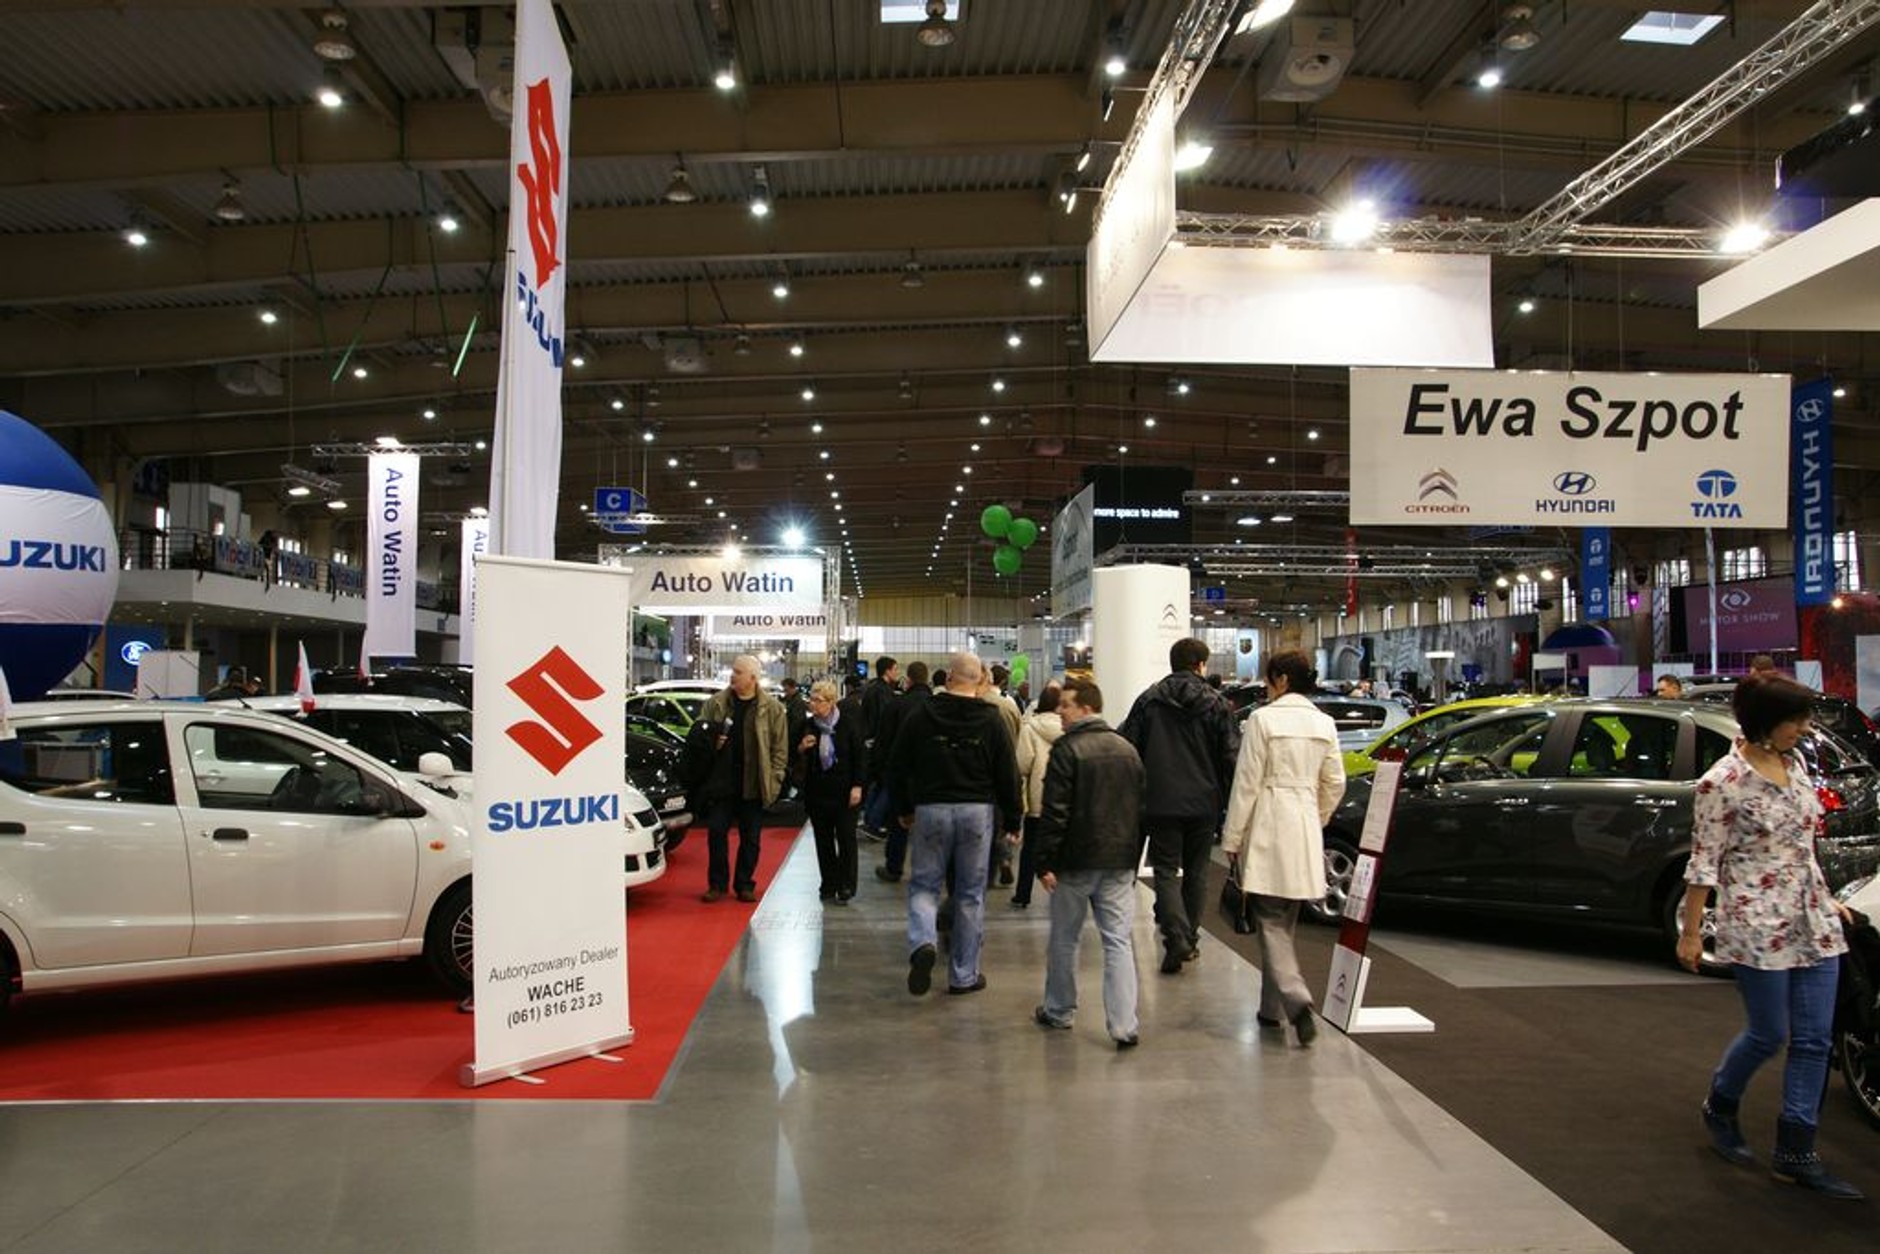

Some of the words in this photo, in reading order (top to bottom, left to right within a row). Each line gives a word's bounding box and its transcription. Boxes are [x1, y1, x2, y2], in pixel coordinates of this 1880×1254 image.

[1403, 384, 1536, 436] Ewa
[1560, 386, 1744, 452] Szpot
[384, 468, 404, 523] Auto
[606, 492, 622, 510] C
[1536, 499, 1616, 513] HYUNDAI
[1140, 508, 1151, 518] to
[1691, 502, 1743, 519] TATA
[473, 529, 488, 553] Au
[382, 531, 403, 597] Watin
[650, 571, 713, 593] Auto
[721, 571, 794, 593] Watin
[1699, 615, 1738, 625] MTOR
[487, 794, 619, 833] SUZUKI
[488, 952, 578, 983] Autoryzowany
[580, 946, 620, 965] Dealer
[528, 976, 586, 1002] WACHE
[507, 1006, 541, 1029] (061)
[545, 1000, 567, 1018] 816
[571, 996, 587, 1012] 23
[588, 992, 604, 1007] 23
